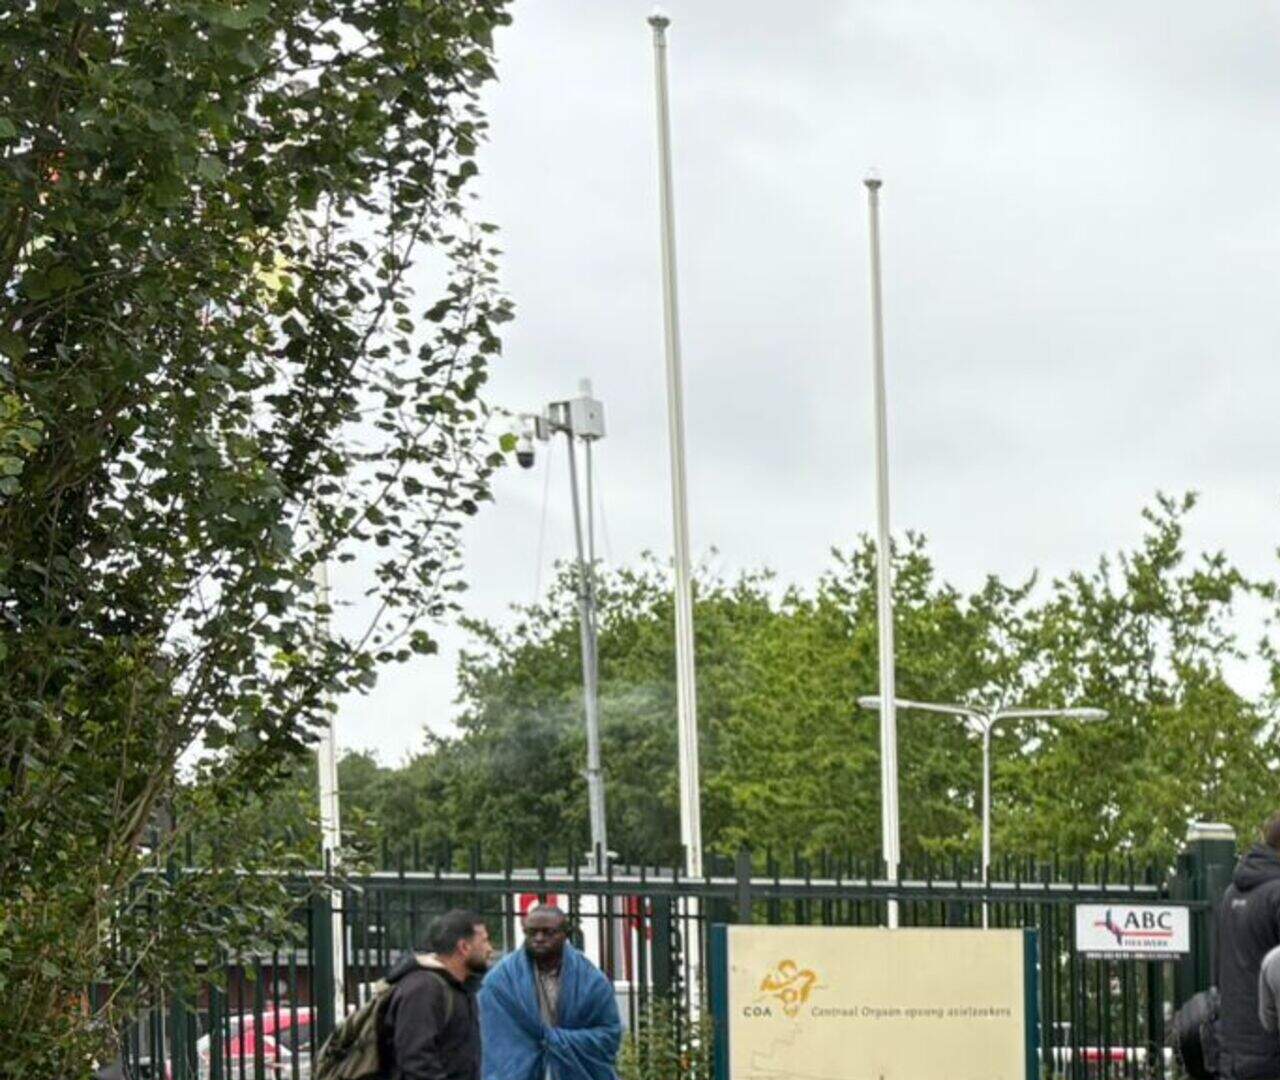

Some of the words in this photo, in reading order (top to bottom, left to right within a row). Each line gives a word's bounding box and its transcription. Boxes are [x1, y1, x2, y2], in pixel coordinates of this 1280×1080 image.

[1125, 911, 1172, 930] ABC
[743, 1006, 772, 1017] COA
[811, 1006, 858, 1017] Centraal
[862, 1006, 901, 1019] Orgaan
